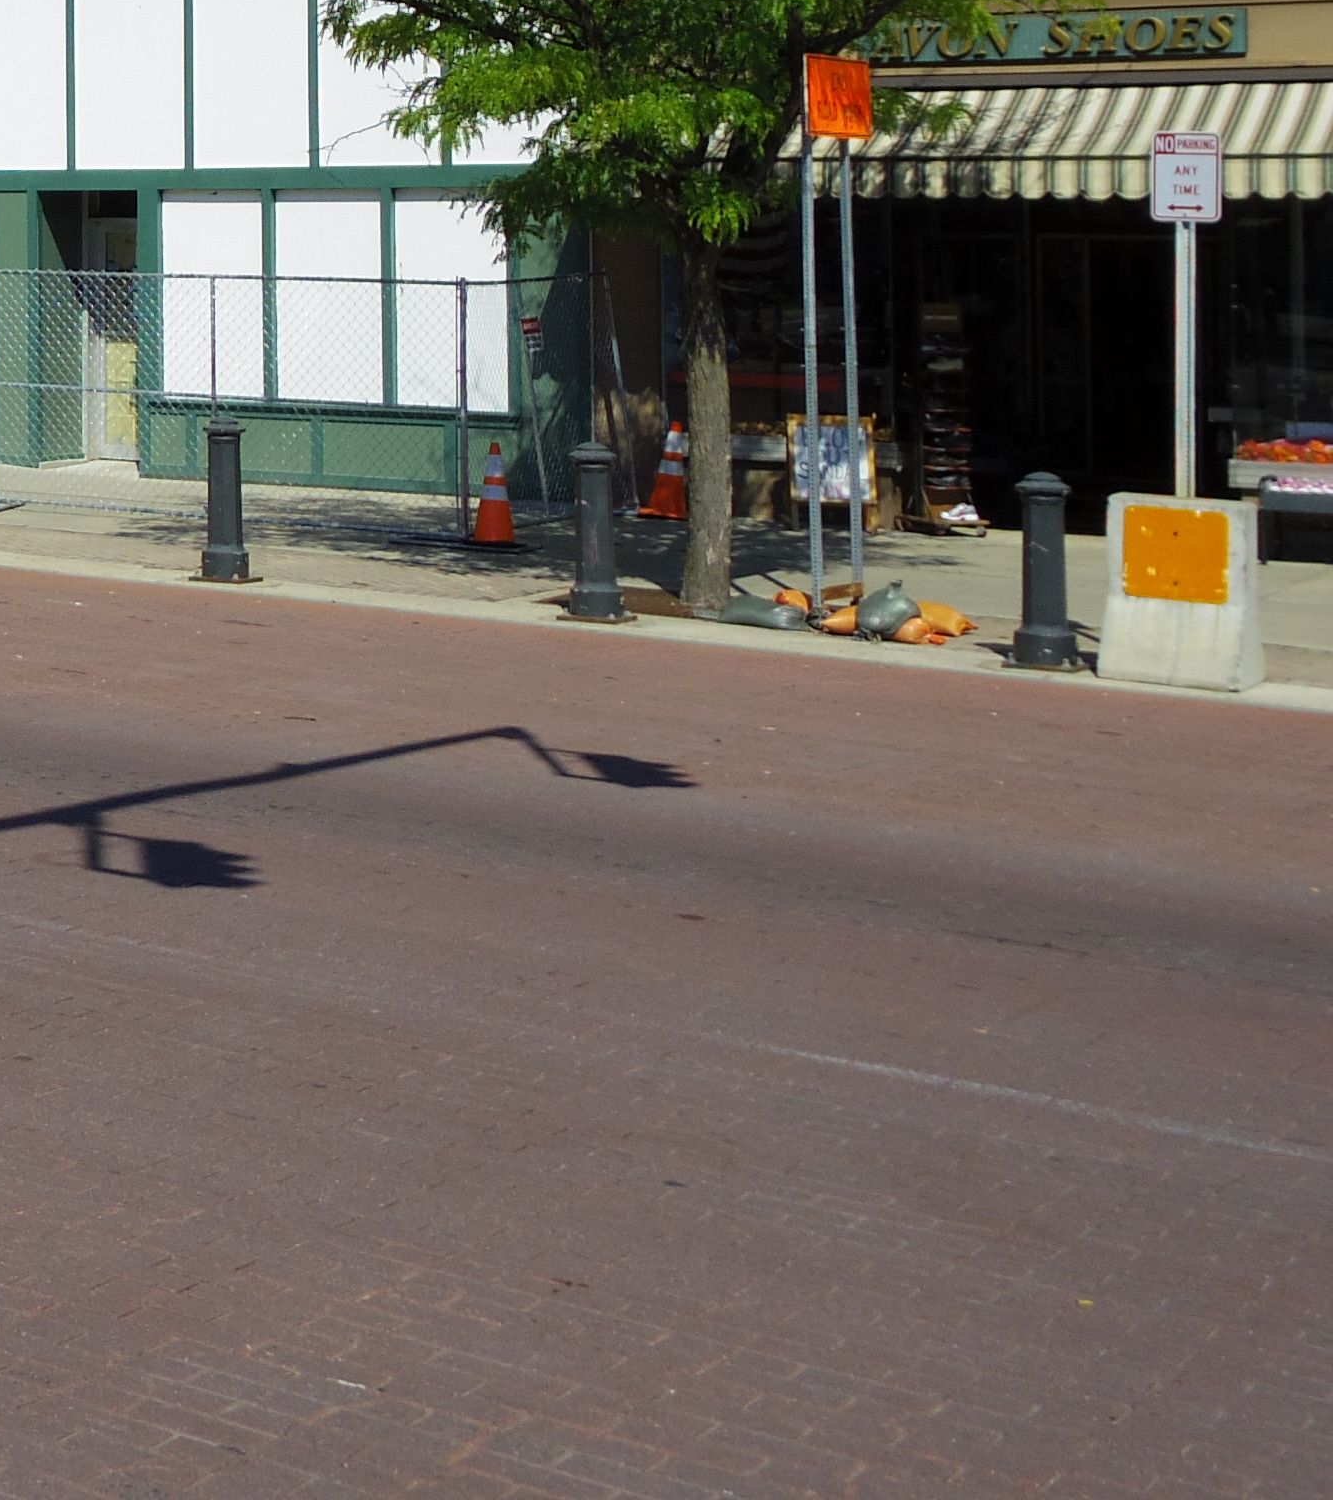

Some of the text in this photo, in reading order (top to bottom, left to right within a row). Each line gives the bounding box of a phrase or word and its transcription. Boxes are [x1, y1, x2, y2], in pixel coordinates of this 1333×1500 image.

[1043, 12, 1235, 57] SHOES
[1156, 135, 1215, 153] NO PARKING
[1175, 165, 1199, 176] ANY
[1173, 184, 1201, 196] TIME
